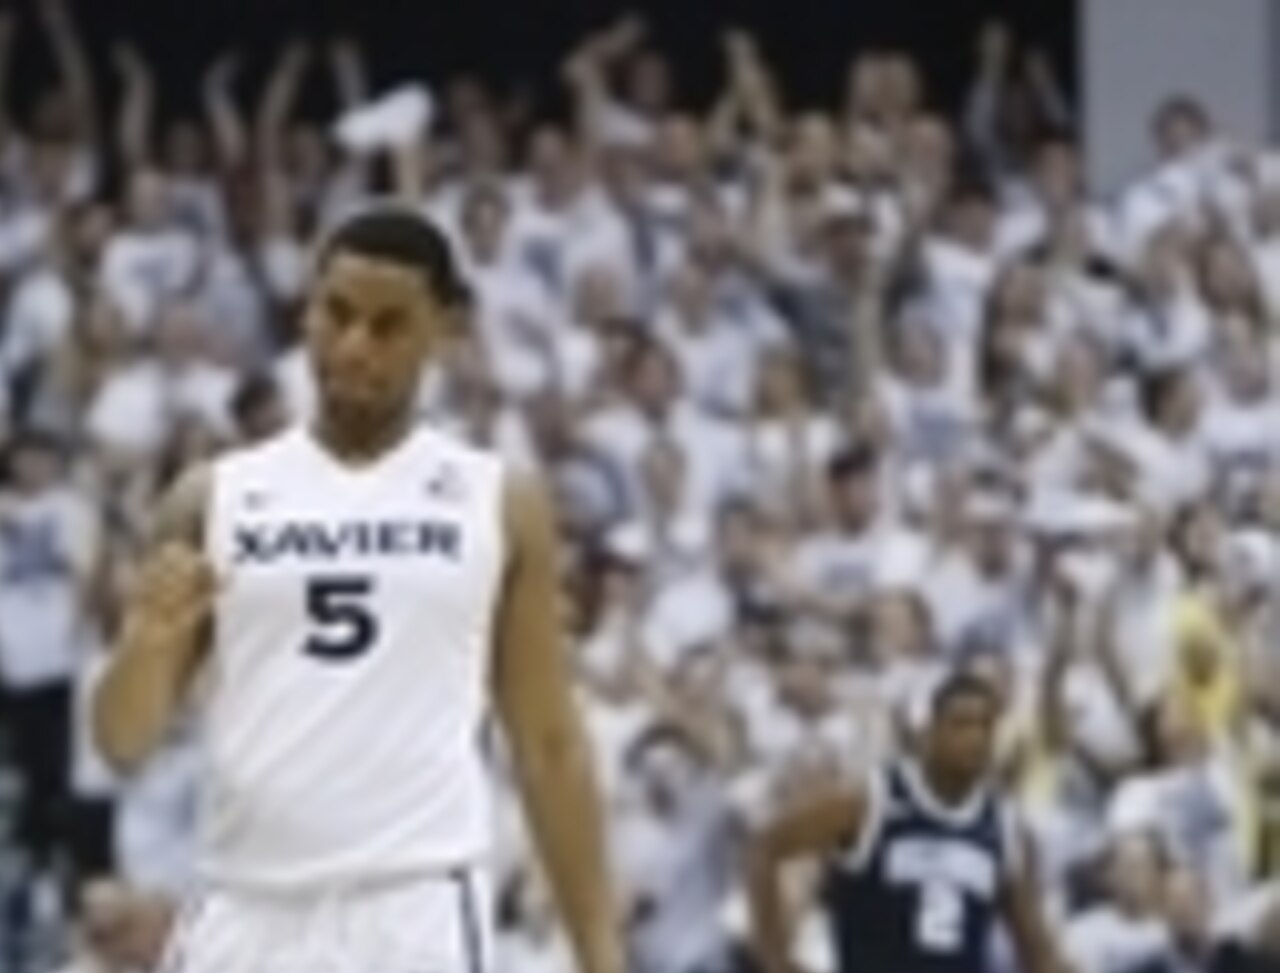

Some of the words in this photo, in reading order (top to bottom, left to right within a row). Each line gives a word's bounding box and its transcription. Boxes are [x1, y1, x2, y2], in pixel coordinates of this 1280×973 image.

[233, 519, 461, 562] XAVIER
[302, 573, 379, 663] 5
[919, 880, 963, 947] 2
